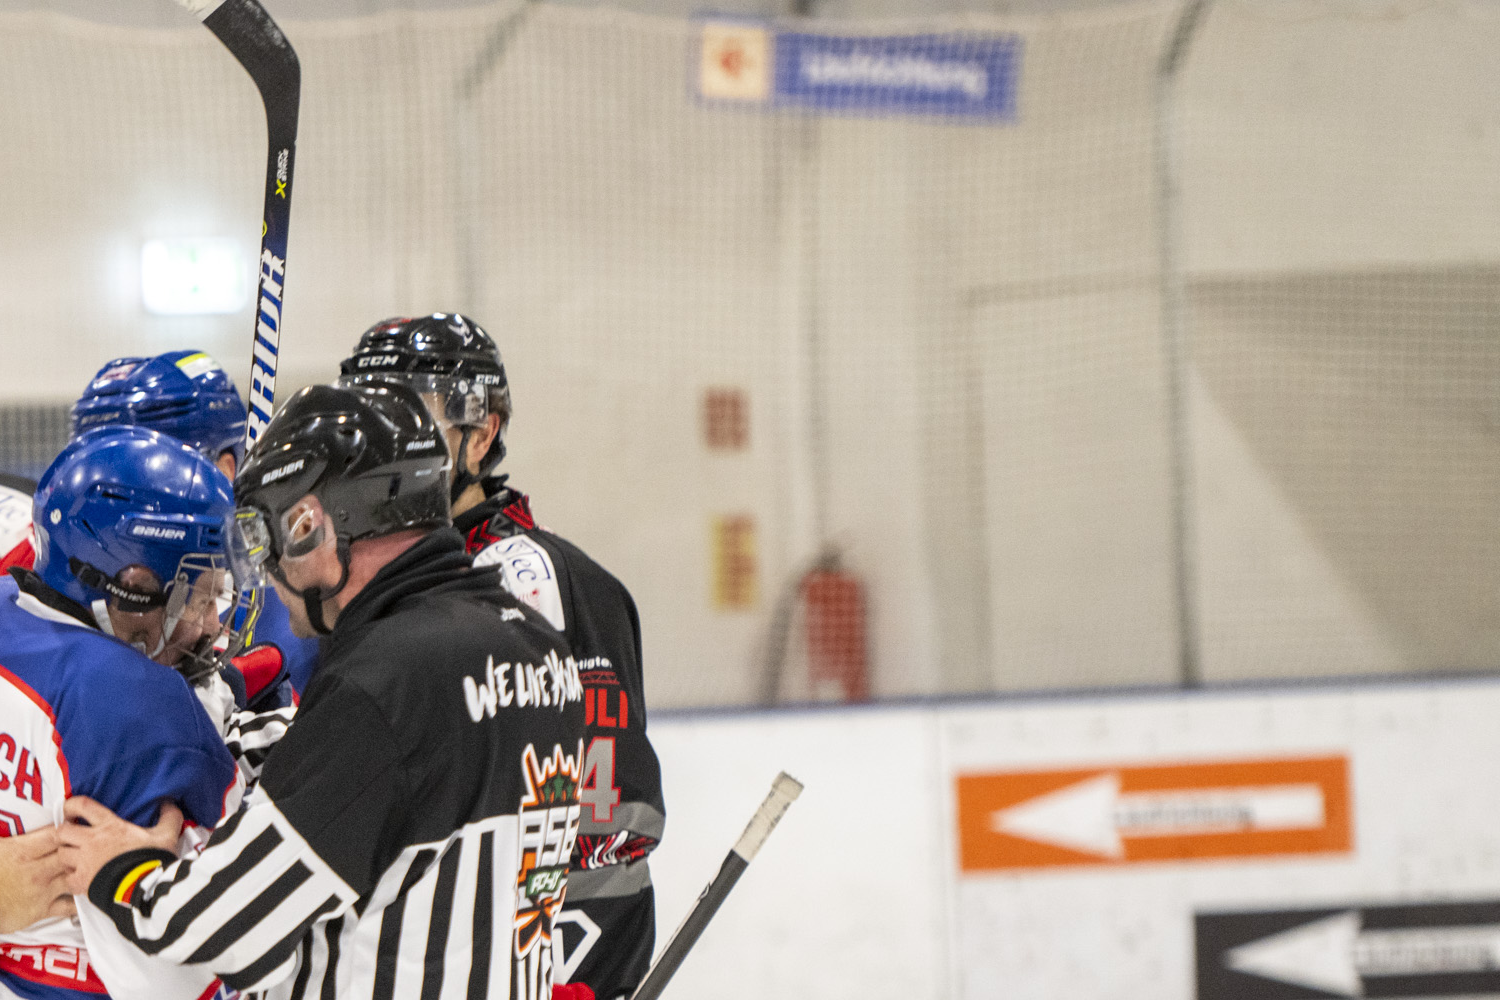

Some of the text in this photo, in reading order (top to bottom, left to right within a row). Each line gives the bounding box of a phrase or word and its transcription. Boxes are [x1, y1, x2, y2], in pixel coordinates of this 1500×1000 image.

[357, 354, 399, 368] CCM
[475, 374, 501, 385] CCM
[261, 459, 305, 486] BAUER
[132, 525, 187, 541] BAUER
[462, 654, 515, 724] WE
